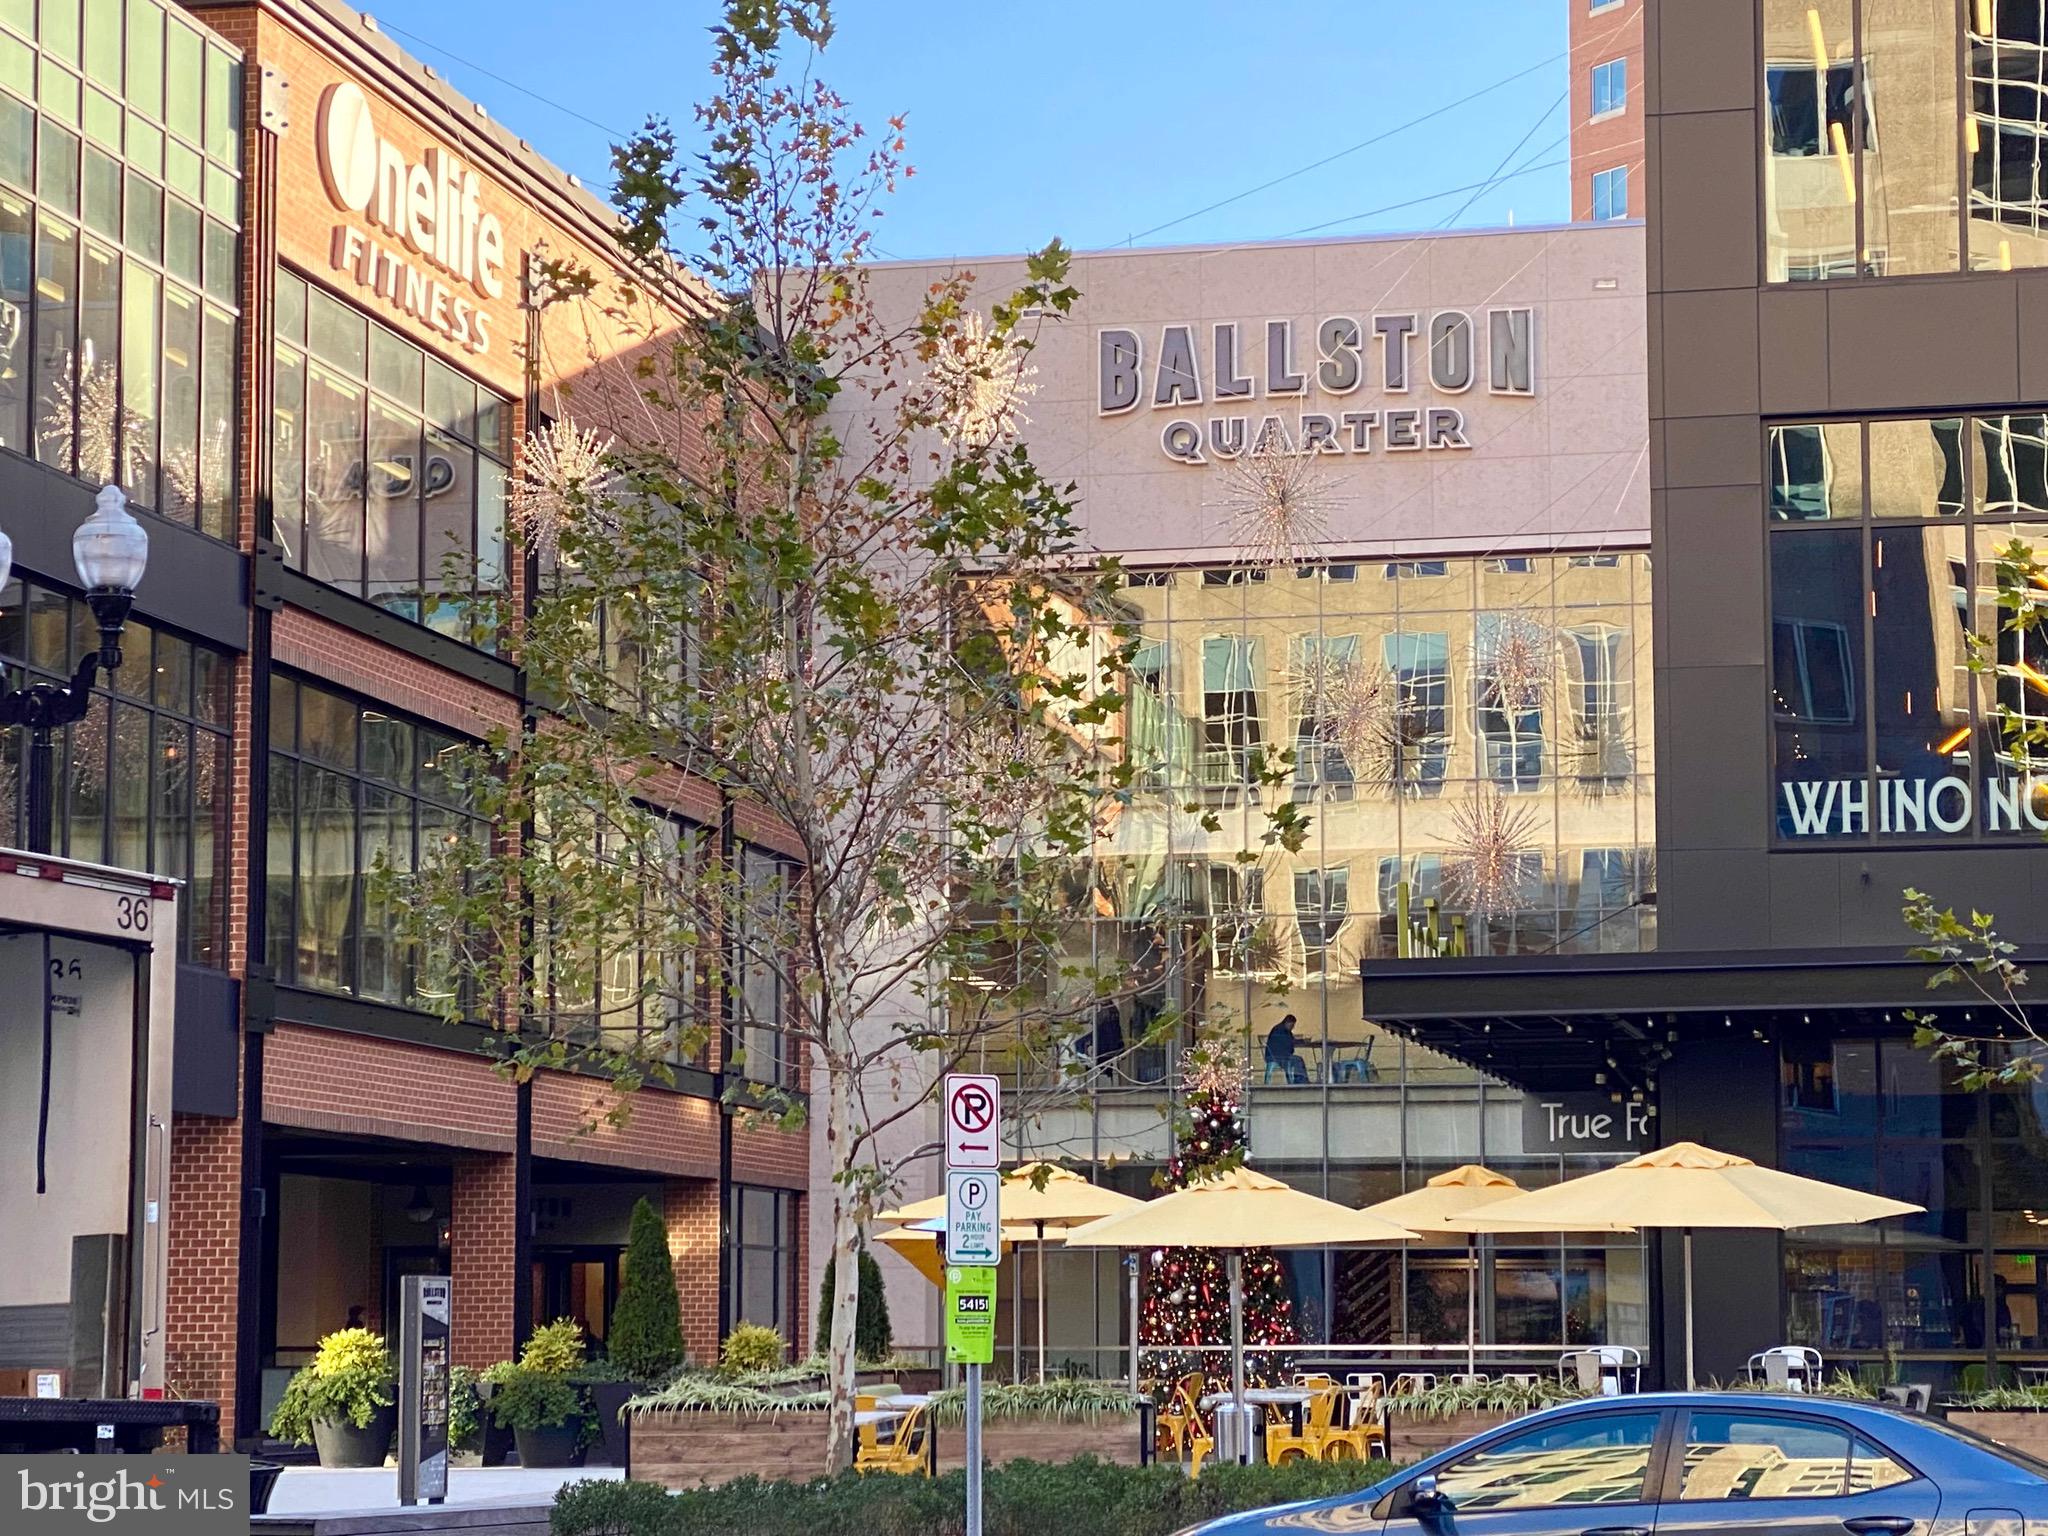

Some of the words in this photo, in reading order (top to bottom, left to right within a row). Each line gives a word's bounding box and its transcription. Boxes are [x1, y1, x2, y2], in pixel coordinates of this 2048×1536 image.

[315, 81, 504, 299] Onelife
[331, 224, 493, 353] FITNESS
[1098, 307, 1535, 417] BALLSTON
[1160, 406, 1472, 464] QUARTER
[1782, 776, 1972, 835] WHINO
[117, 896, 149, 932] 36
[1540, 1102, 1613, 1142] True
[969, 1182, 980, 1205] P
[955, 1222, 991, 1232] PARKING
[965, 1211, 982, 1221] PAY
[962, 1234, 970, 1249] 2
[959, 1298, 988, 1311] 54151
